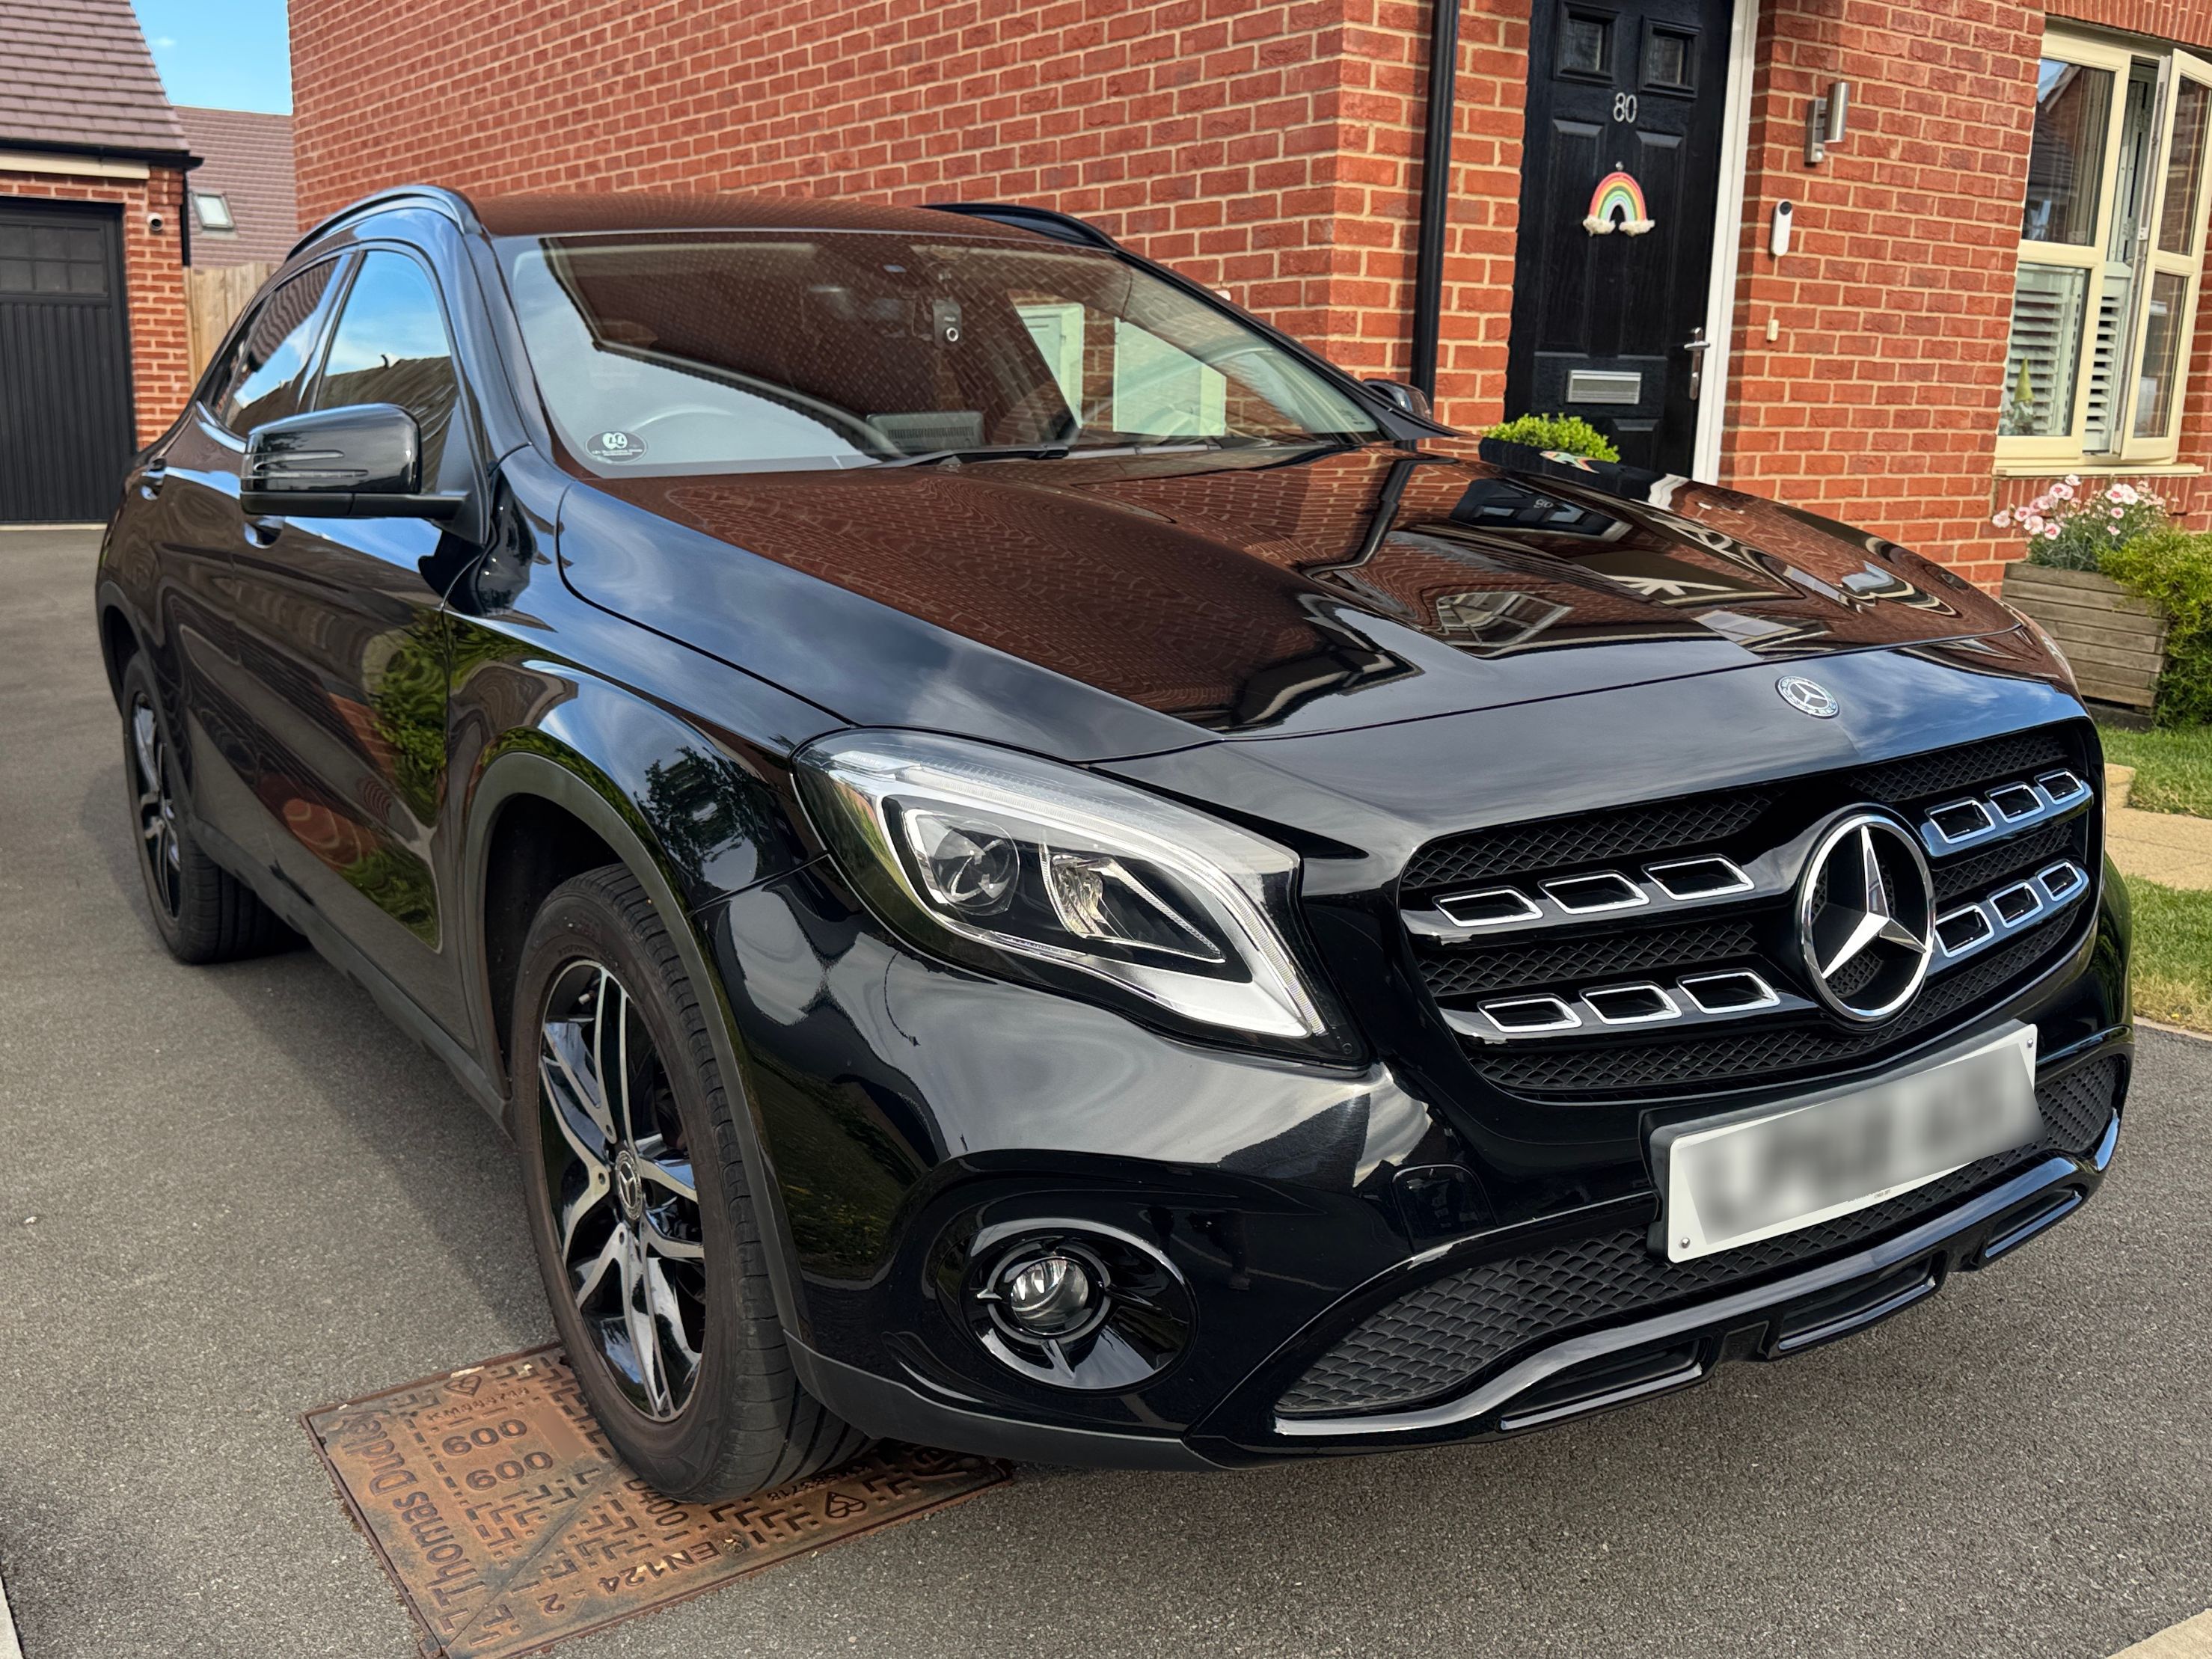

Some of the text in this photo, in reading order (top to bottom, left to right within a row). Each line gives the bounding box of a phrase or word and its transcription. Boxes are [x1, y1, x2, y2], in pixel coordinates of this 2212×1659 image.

[1614, 92, 1637, 123] 80
[442, 1419, 527, 1456] 600
[465, 1451, 553, 1491] 600
[393, 1491, 485, 1608] Thomas
[598, 1541, 722, 1594] EN124
